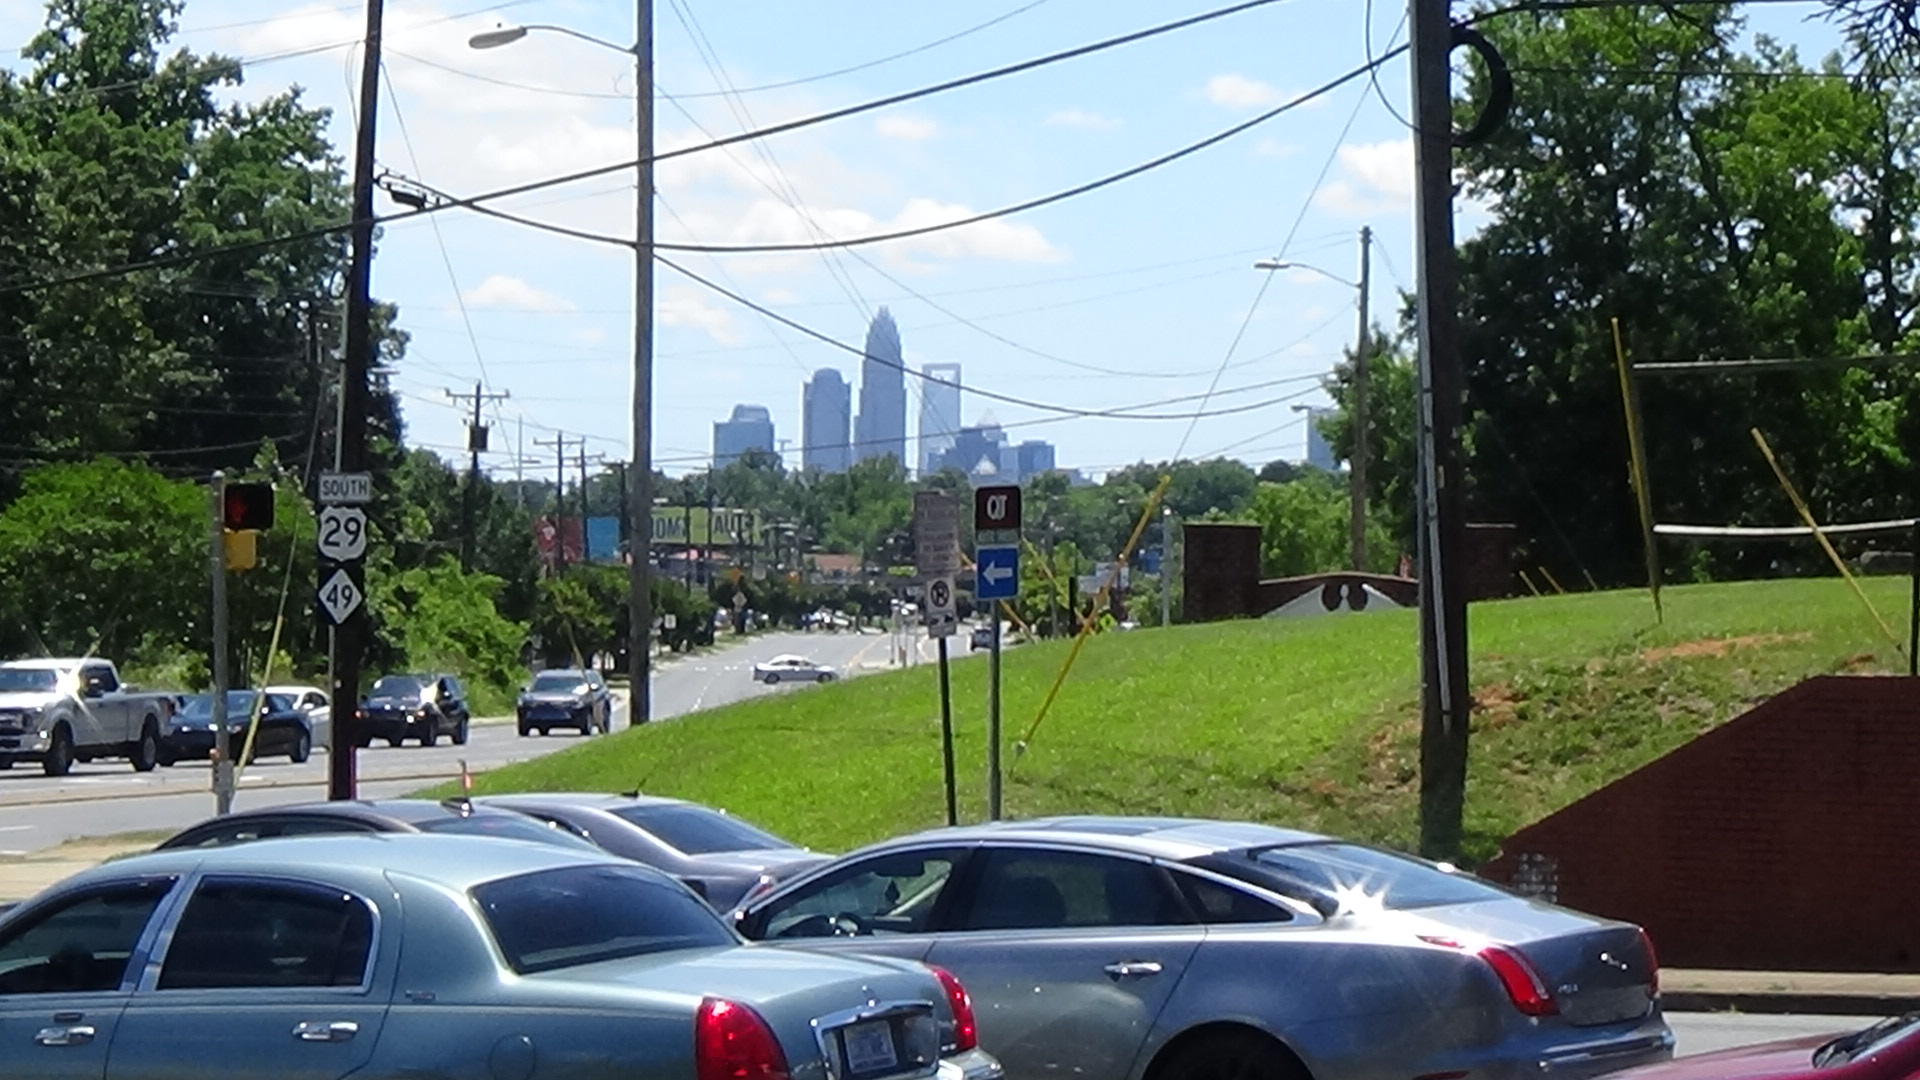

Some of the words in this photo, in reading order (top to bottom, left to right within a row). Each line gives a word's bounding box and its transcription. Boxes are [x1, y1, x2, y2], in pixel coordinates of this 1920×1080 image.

[322, 479, 368, 497] SOUTH
[323, 515, 362, 548] 29
[326, 584, 354, 609] 49
